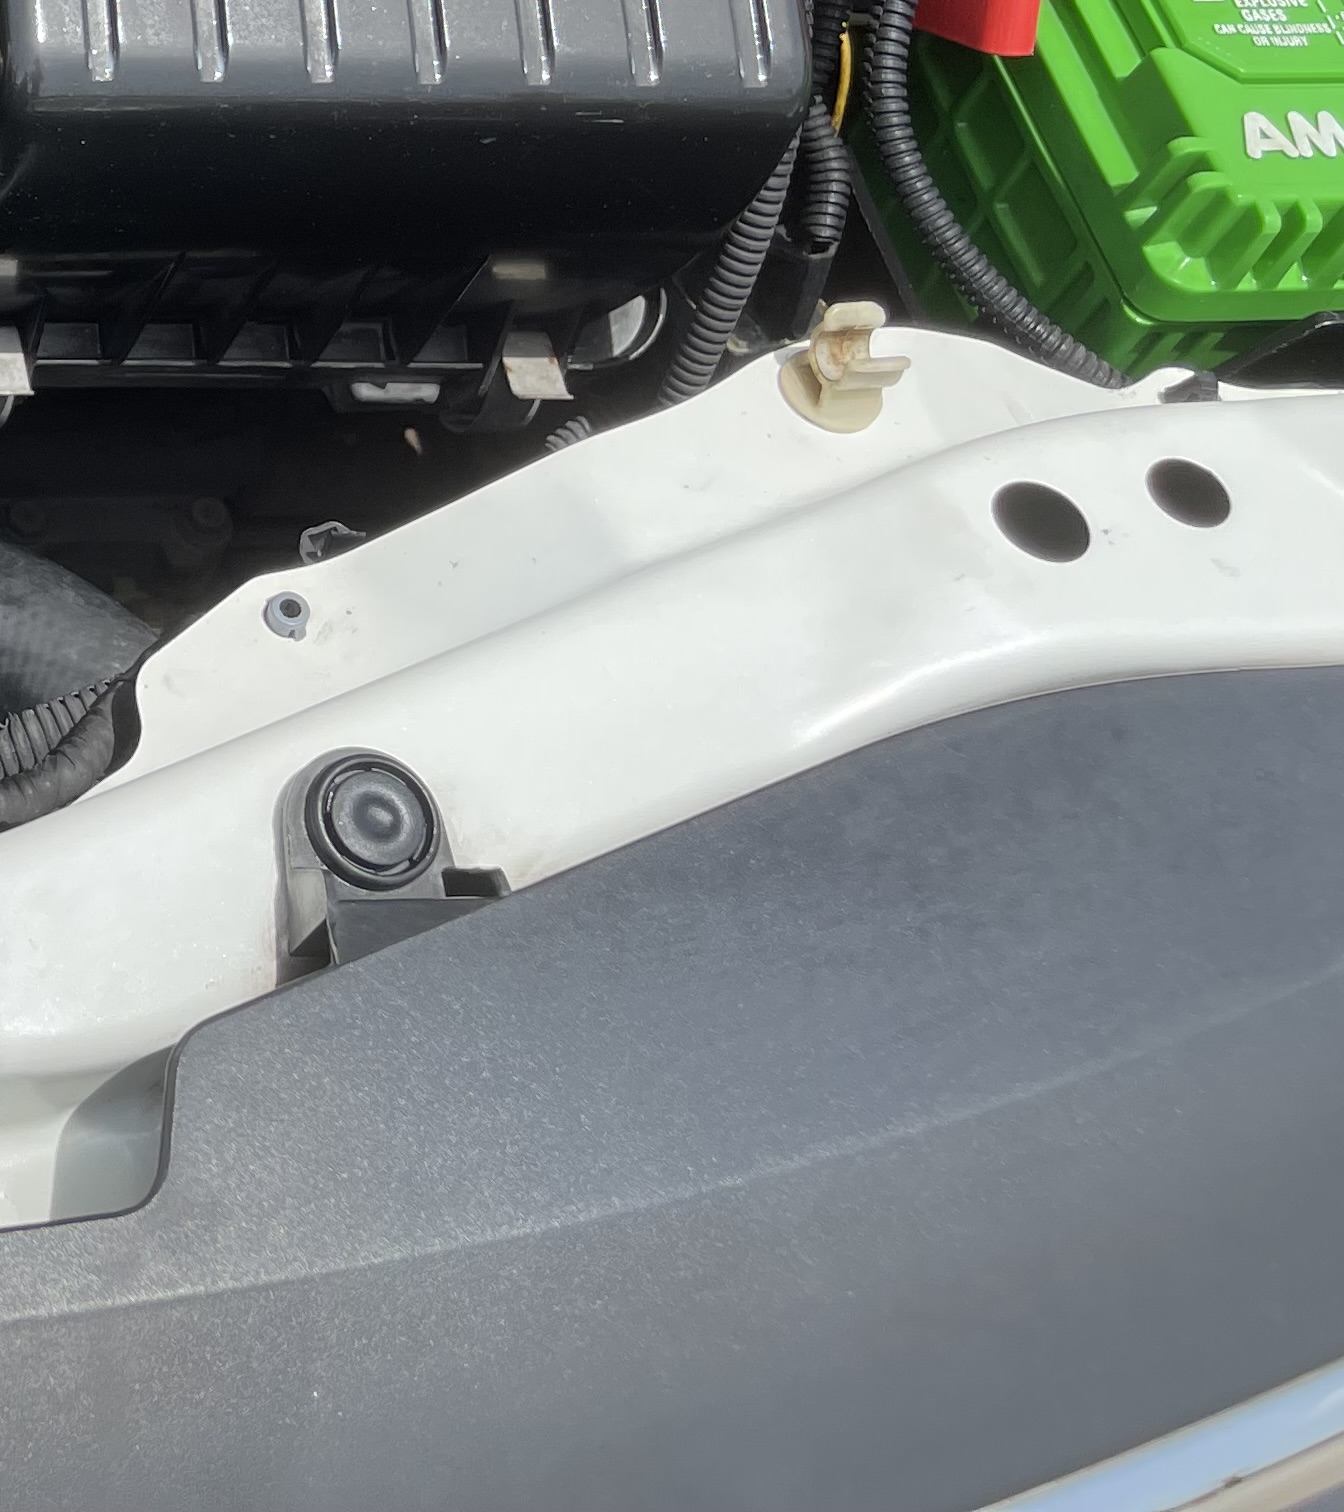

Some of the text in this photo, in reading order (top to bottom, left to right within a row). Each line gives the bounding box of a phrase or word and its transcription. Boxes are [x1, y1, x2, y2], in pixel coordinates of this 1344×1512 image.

[1240, 9, 1287, 21] GASES
[1213, 23, 1332, 34] CAN CAUSE BLINDNESS
[1253, 35, 1308, 46] OR INJURY
